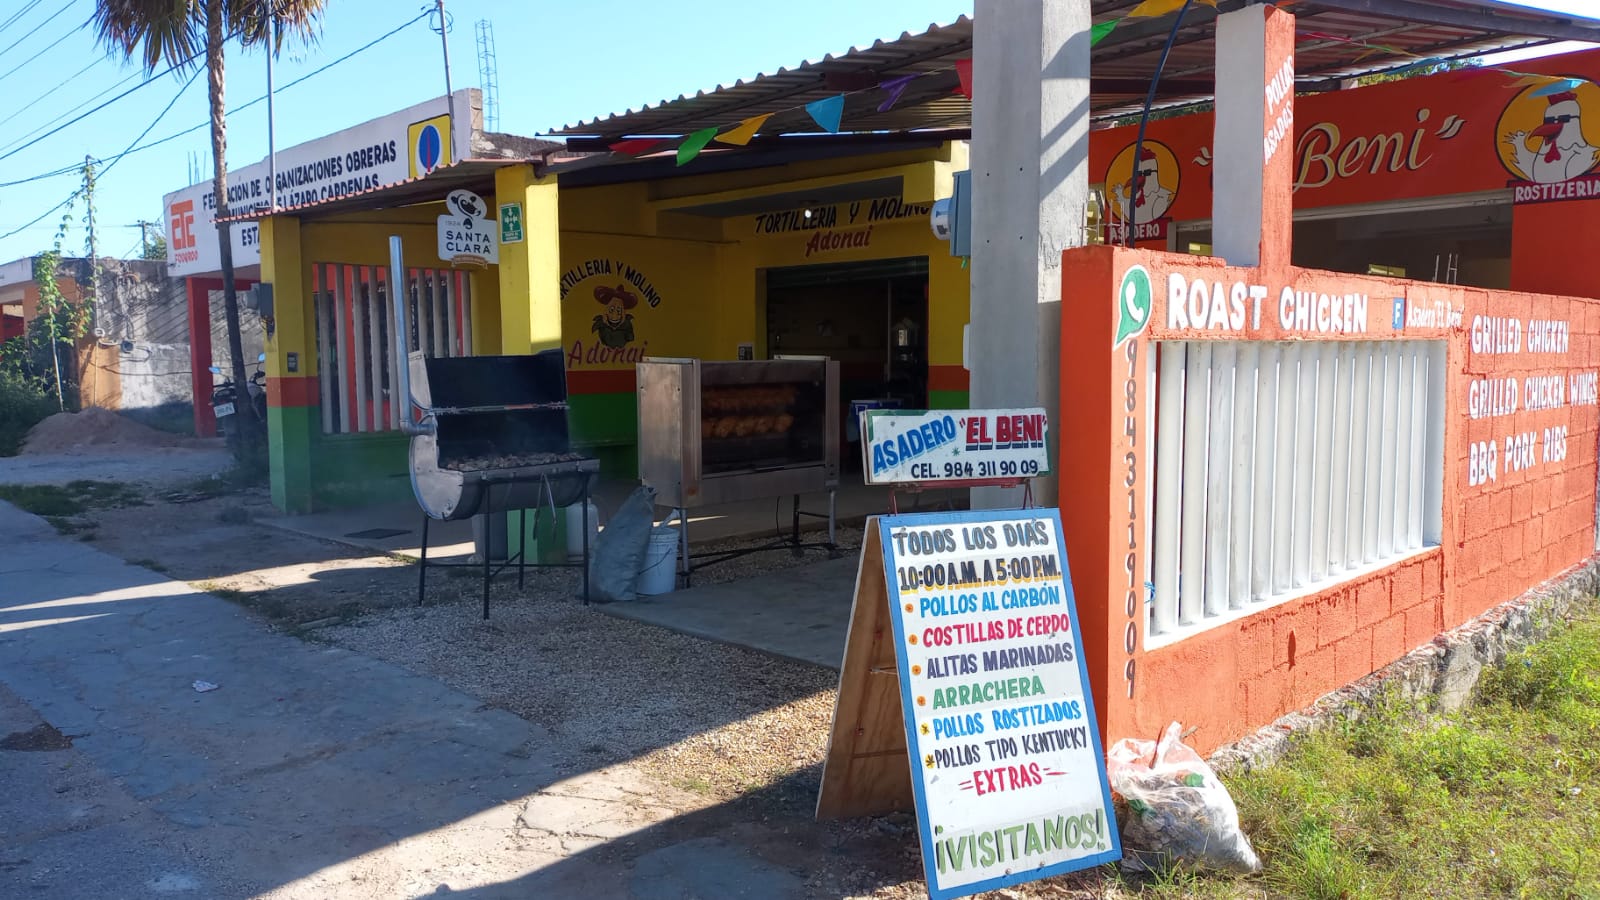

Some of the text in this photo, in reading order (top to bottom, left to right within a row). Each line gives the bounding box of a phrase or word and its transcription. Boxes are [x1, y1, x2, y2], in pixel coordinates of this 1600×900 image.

[1265, 55, 1294, 116] POLLOS
[1263, 100, 1293, 165] ASADOS
[251, 179, 261, 198] DE
[266, 156, 342, 193] OGANIZACIONES
[346, 140, 396, 172] OBRERAS
[1515, 180, 1600, 202] ROSTIZERIA
[755, 204, 836, 233] TORTILLERIA
[849, 202, 860, 223] Y
[446, 230, 490, 243] SANTA
[446, 242, 491, 254] CLARA
[806, 226, 874, 256] Adonai
[559, 259, 661, 308] RTILLERIA Y MOLINO
[1168, 272, 1368, 333] ROAST CHICKEN
[1406, 298, 1435, 328] Asadero
[1471, 315, 1570, 354] GRILLED CHICKEN
[568, 340, 648, 369] Adonai
[1469, 371, 1598, 419] GRILLED CHICKEN WINGS
[873, 415, 957, 475] ASADERO
[1469, 424, 1567, 487] BBQ PORK RIBS
[911, 459, 1038, 479] CEL. 984 311 90 09
[892, 528, 957, 556] TODOS
[963, 525, 997, 550] LOS
[898, 563, 945, 592] 10:00
[984, 559, 994, 585] A
[996, 557, 1031, 582] 5:00
[920, 582, 1060, 618] POLLOS AL CARBÓN
[923, 613, 1069, 648] COSTILLAS DE CERDO
[927, 642, 1073, 679] ALITAS MARINADAS
[932, 675, 1046, 710] ARRACHERA
[933, 700, 1082, 740] POLLOS ROSTIZADOS
[934, 725, 1087, 769] POLLOS TIPO KENTUCKY
[934, 807, 1107, 875] ¡VISITANOS!
